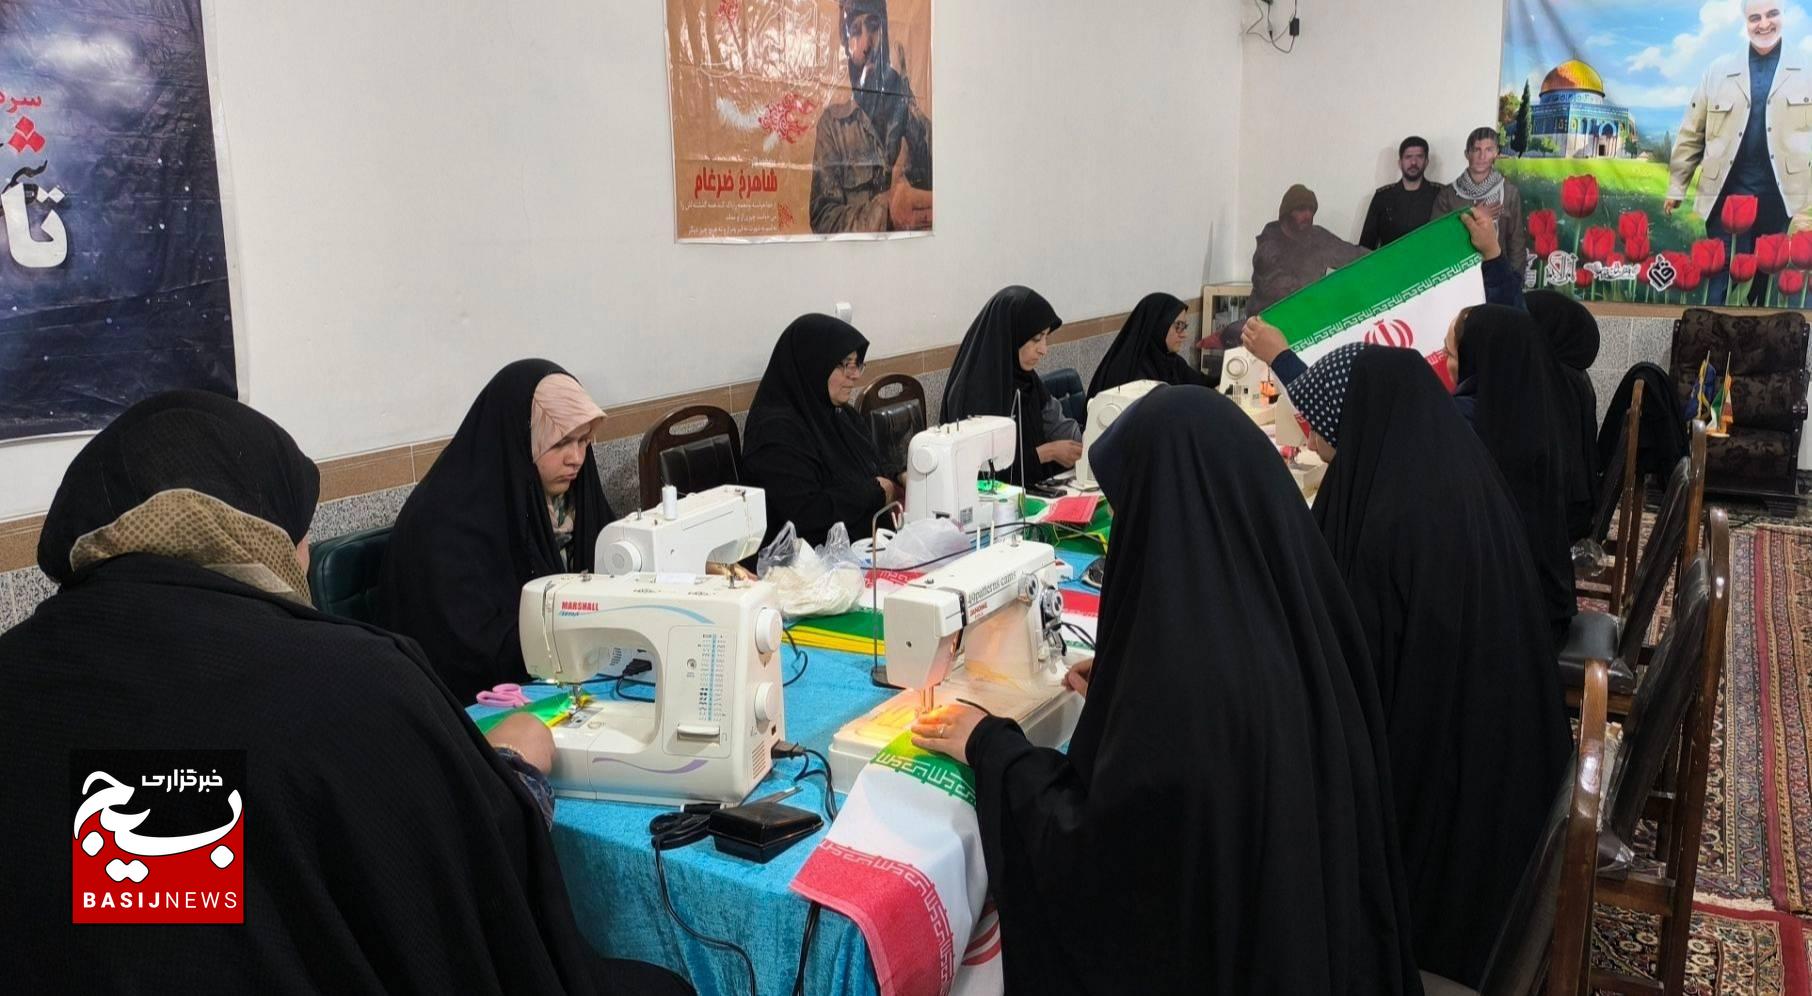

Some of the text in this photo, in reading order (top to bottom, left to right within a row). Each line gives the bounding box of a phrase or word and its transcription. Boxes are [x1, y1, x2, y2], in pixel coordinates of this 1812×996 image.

[695, 167, 778, 199] شاهرخ ضرغام
[561, 601, 599, 611] MARSHALL
